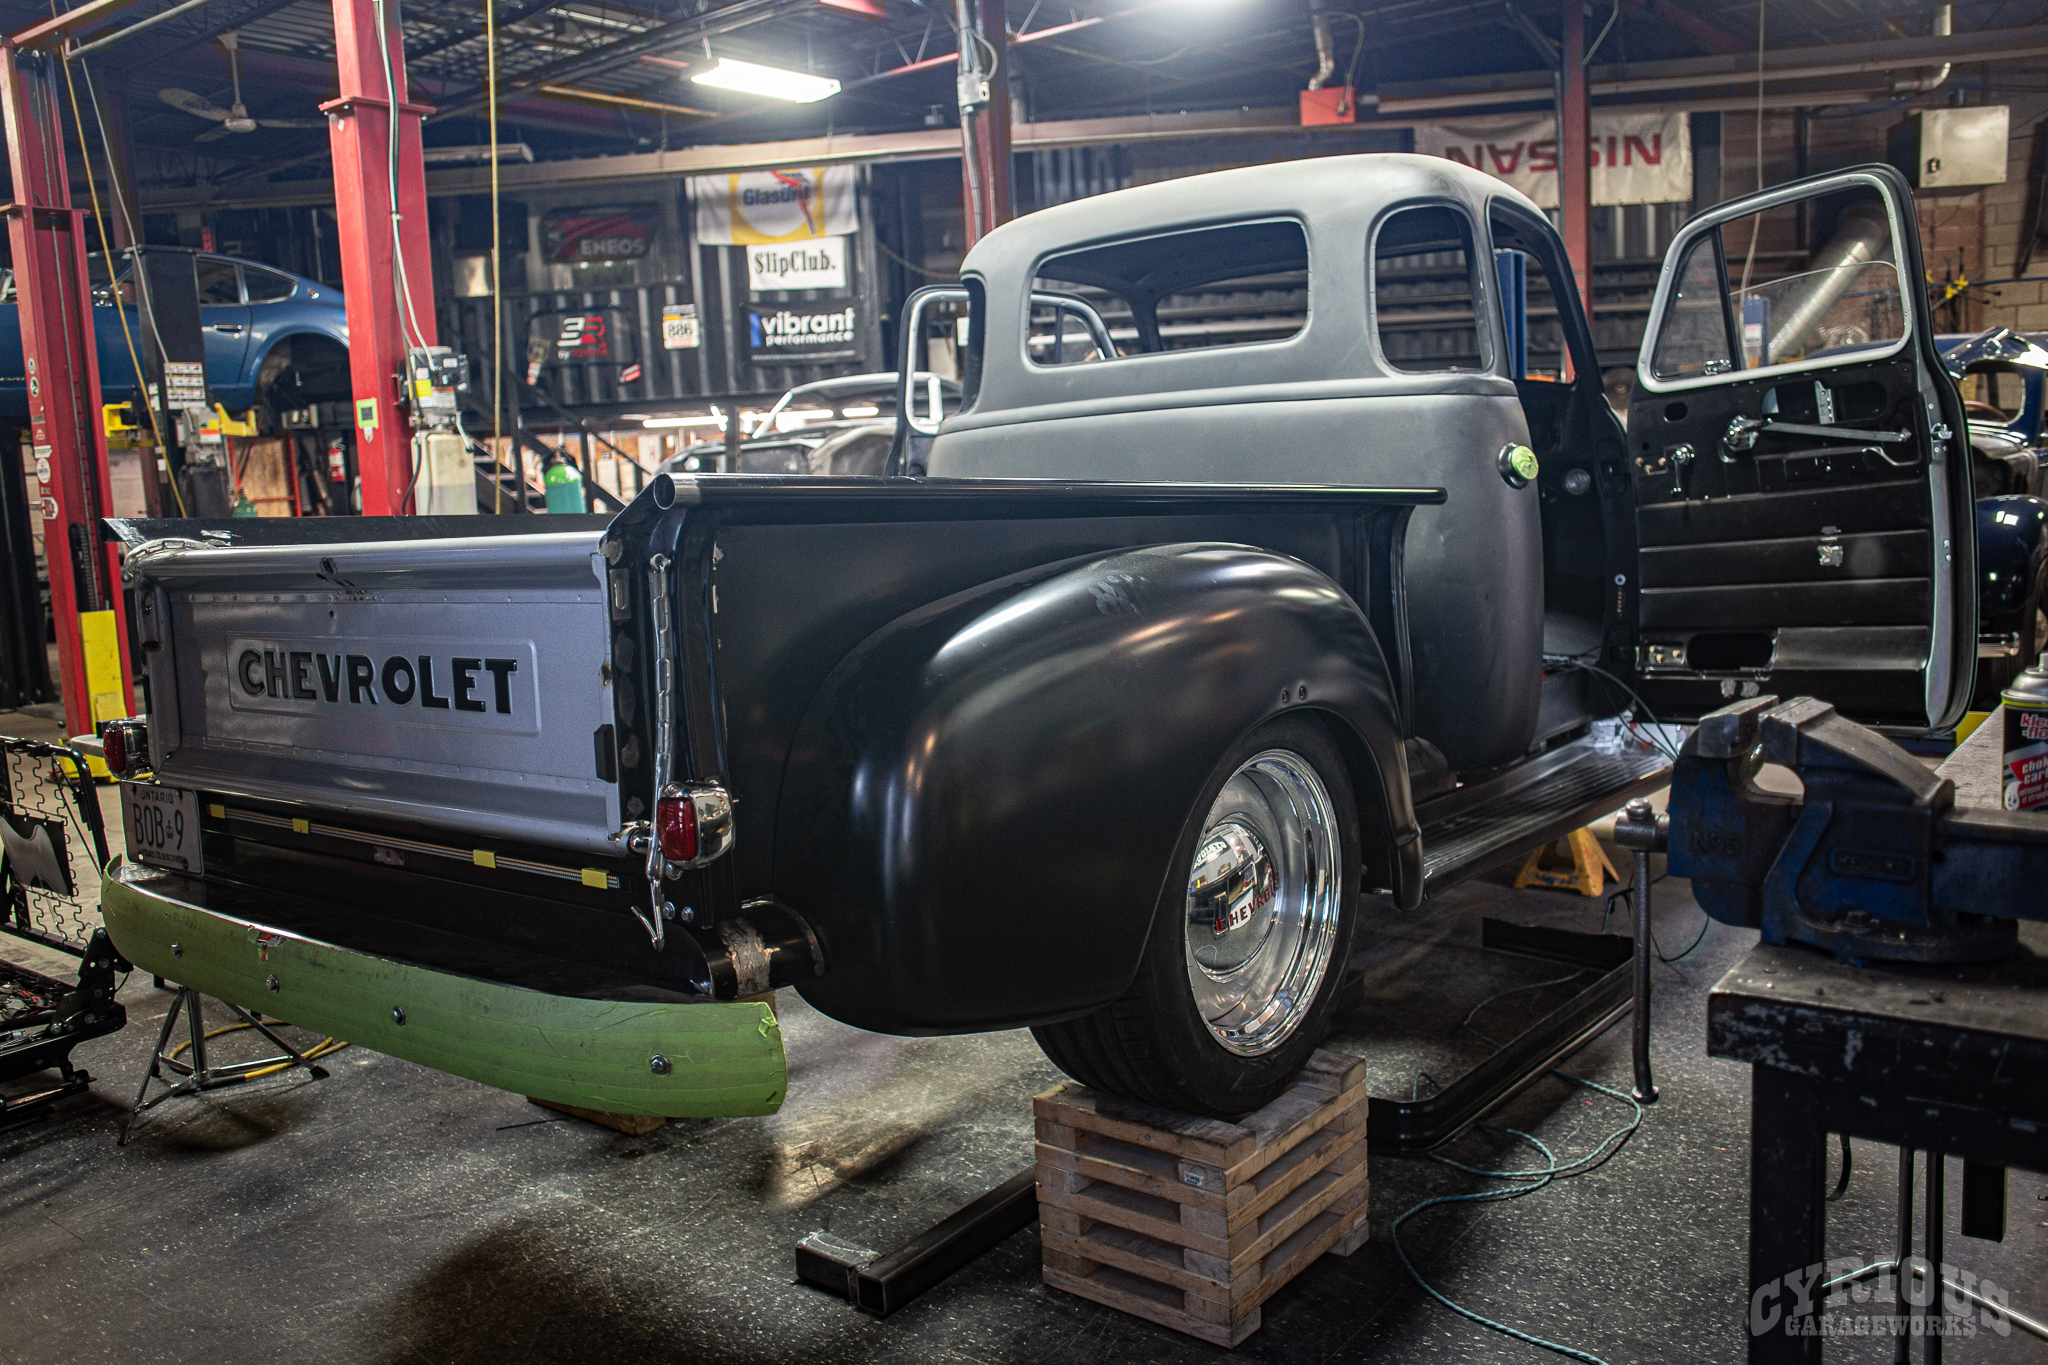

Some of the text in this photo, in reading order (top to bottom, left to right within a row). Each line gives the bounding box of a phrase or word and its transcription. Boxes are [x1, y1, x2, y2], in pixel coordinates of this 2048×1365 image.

[581, 237, 646, 256] ENEOS
[755, 250, 836, 277] SlipClub.
[761, 307, 856, 335] vibrant
[765, 330, 855, 348] performance
[238, 649, 518, 714] CHEVROLET
[141, 789, 174, 804] ONTARIO
[133, 803, 165, 849] BOB
